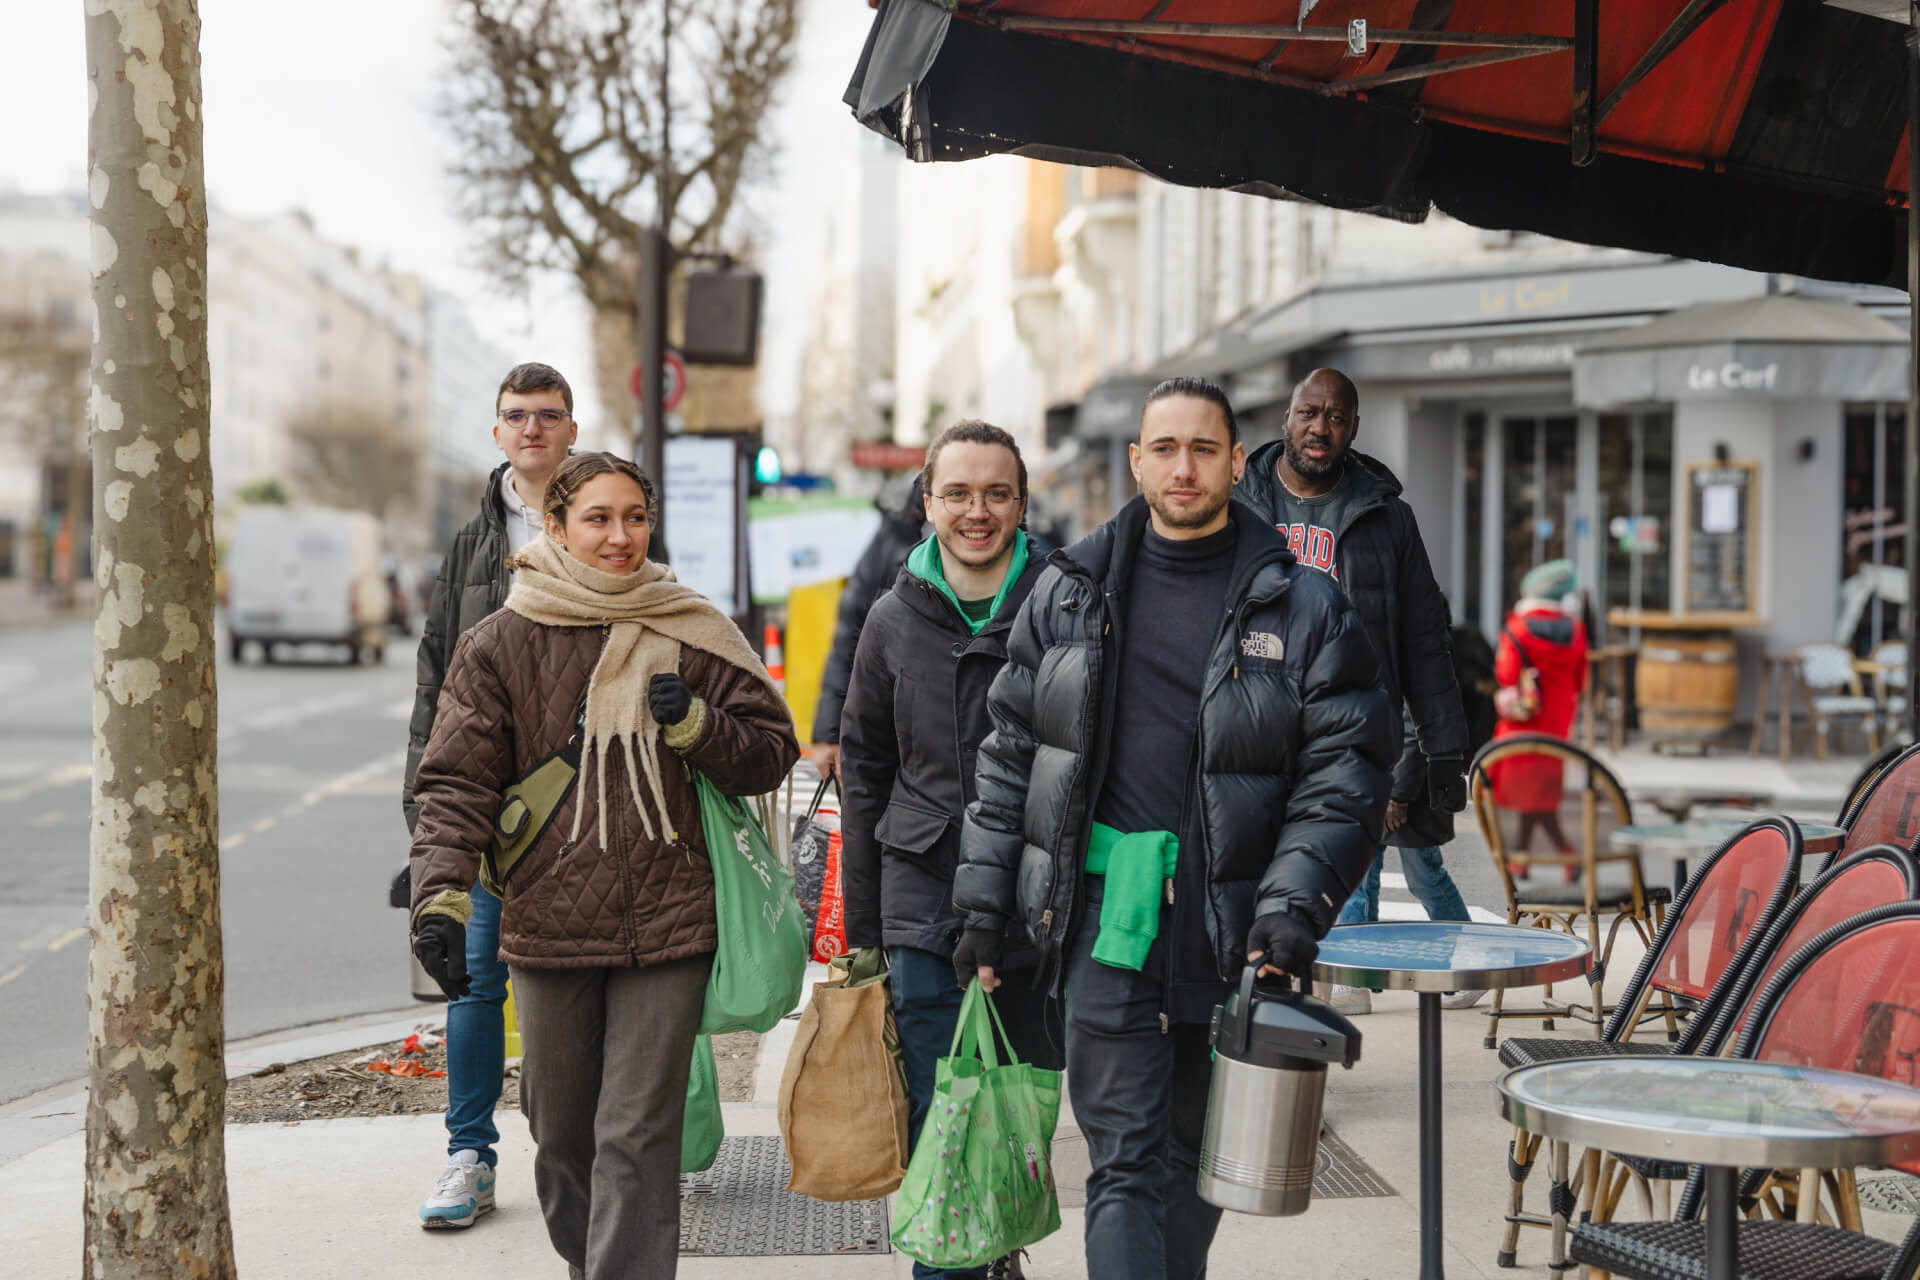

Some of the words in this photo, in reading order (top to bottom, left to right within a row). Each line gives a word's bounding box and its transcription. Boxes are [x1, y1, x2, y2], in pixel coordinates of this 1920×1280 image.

[1481, 288, 1507, 313] Le
[1515, 281, 1569, 309] Cerf
[1688, 365, 1716, 390] Le
[1721, 362, 1778, 389] Cerf
[1276, 523, 1340, 582] RID
[1240, 638, 1268, 650] ORTH
[1249, 631, 1268, 641] THE
[1243, 648, 1268, 658] FACE
